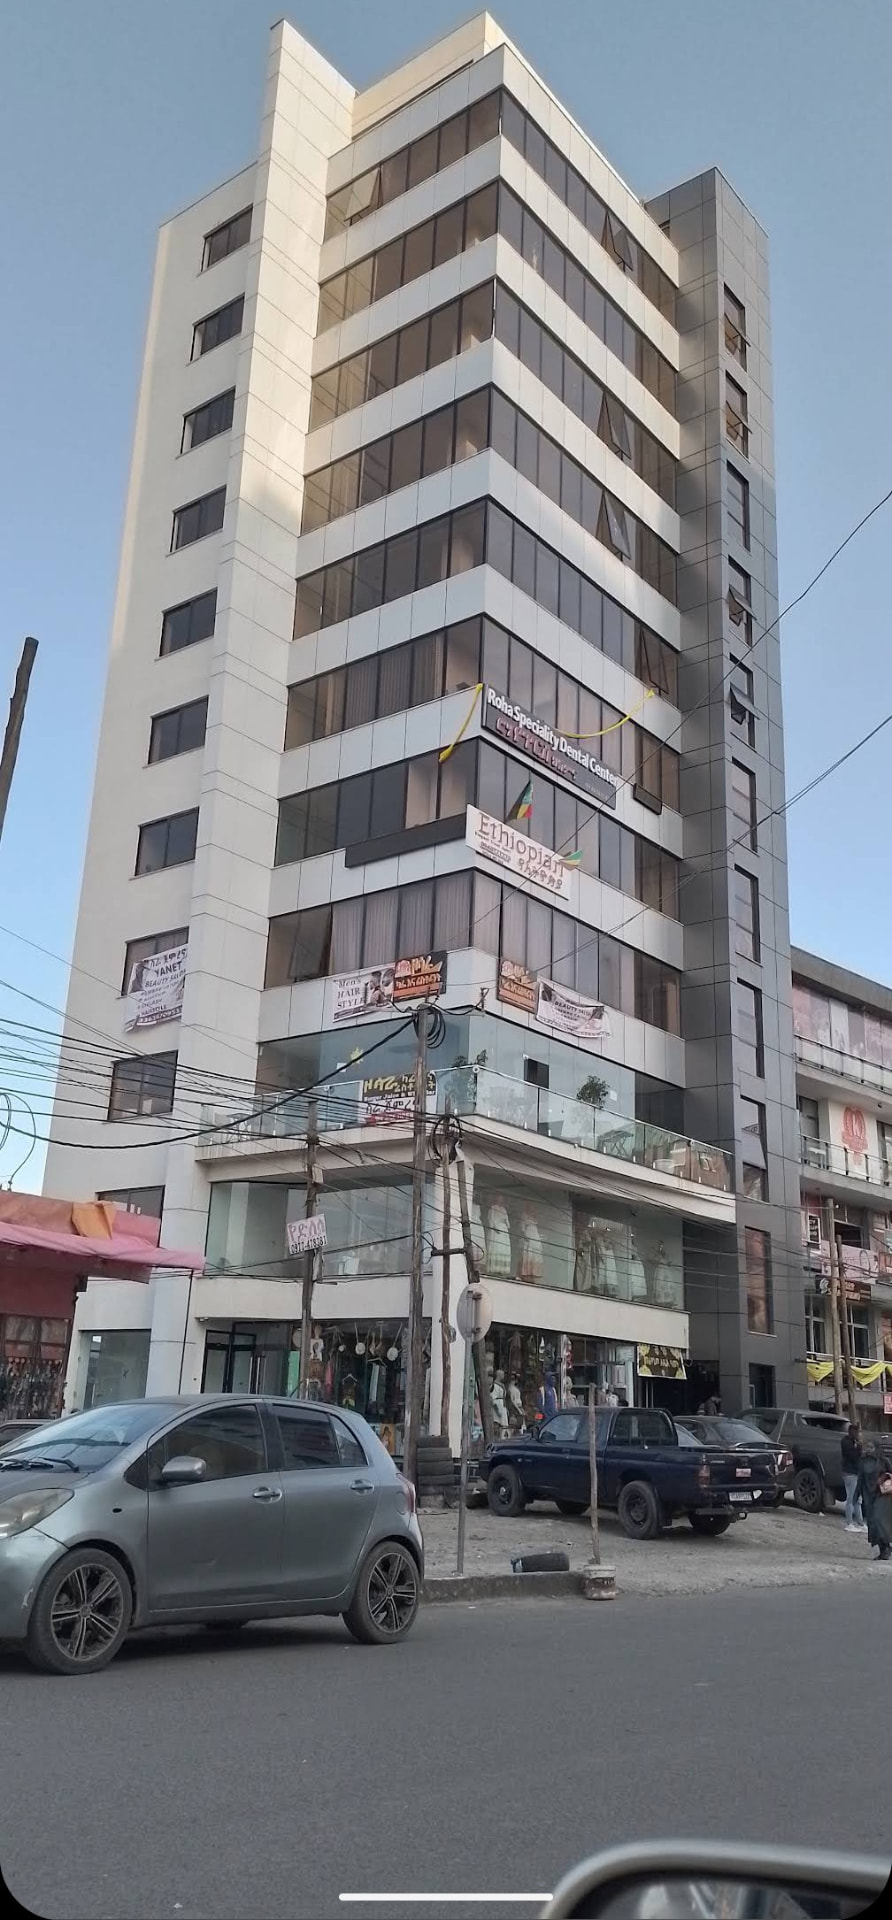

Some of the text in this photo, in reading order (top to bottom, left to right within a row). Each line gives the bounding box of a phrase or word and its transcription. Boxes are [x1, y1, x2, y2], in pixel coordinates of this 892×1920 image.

[487, 688, 619, 786] Roha Speciality Dental Center
[479, 812, 564, 878] Ethiopian
[155, 961, 183, 977] YANET
[337, 987, 361, 1000] HAIR
